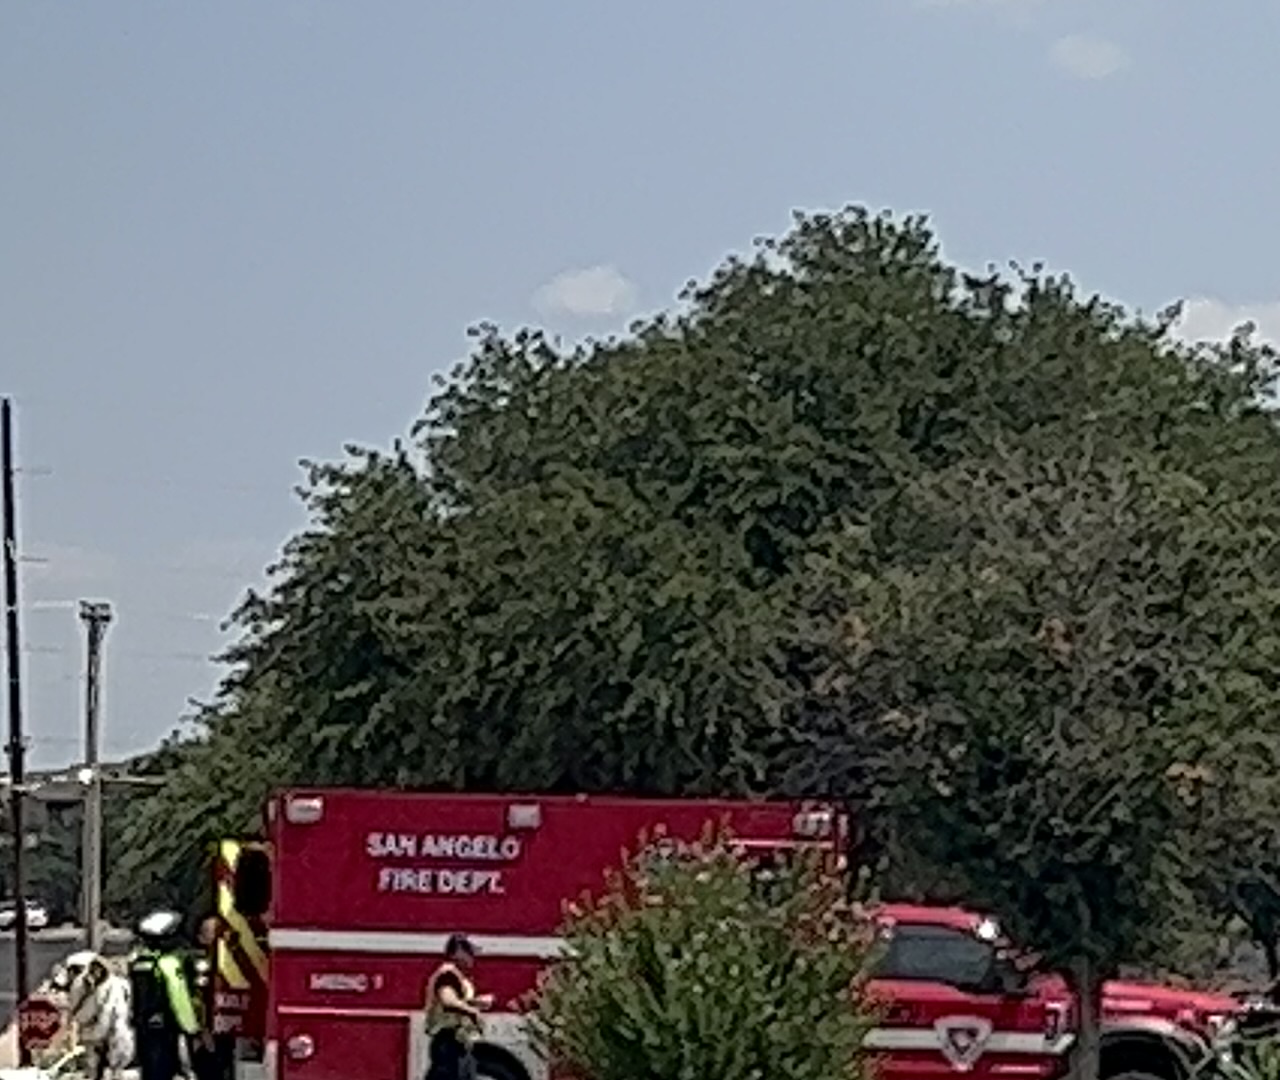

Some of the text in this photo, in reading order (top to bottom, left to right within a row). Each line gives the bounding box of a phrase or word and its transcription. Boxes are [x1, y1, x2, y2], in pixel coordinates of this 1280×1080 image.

[367, 832, 520, 860] SAN ANGELO
[379, 867, 505, 894] FIRE DEPT.
